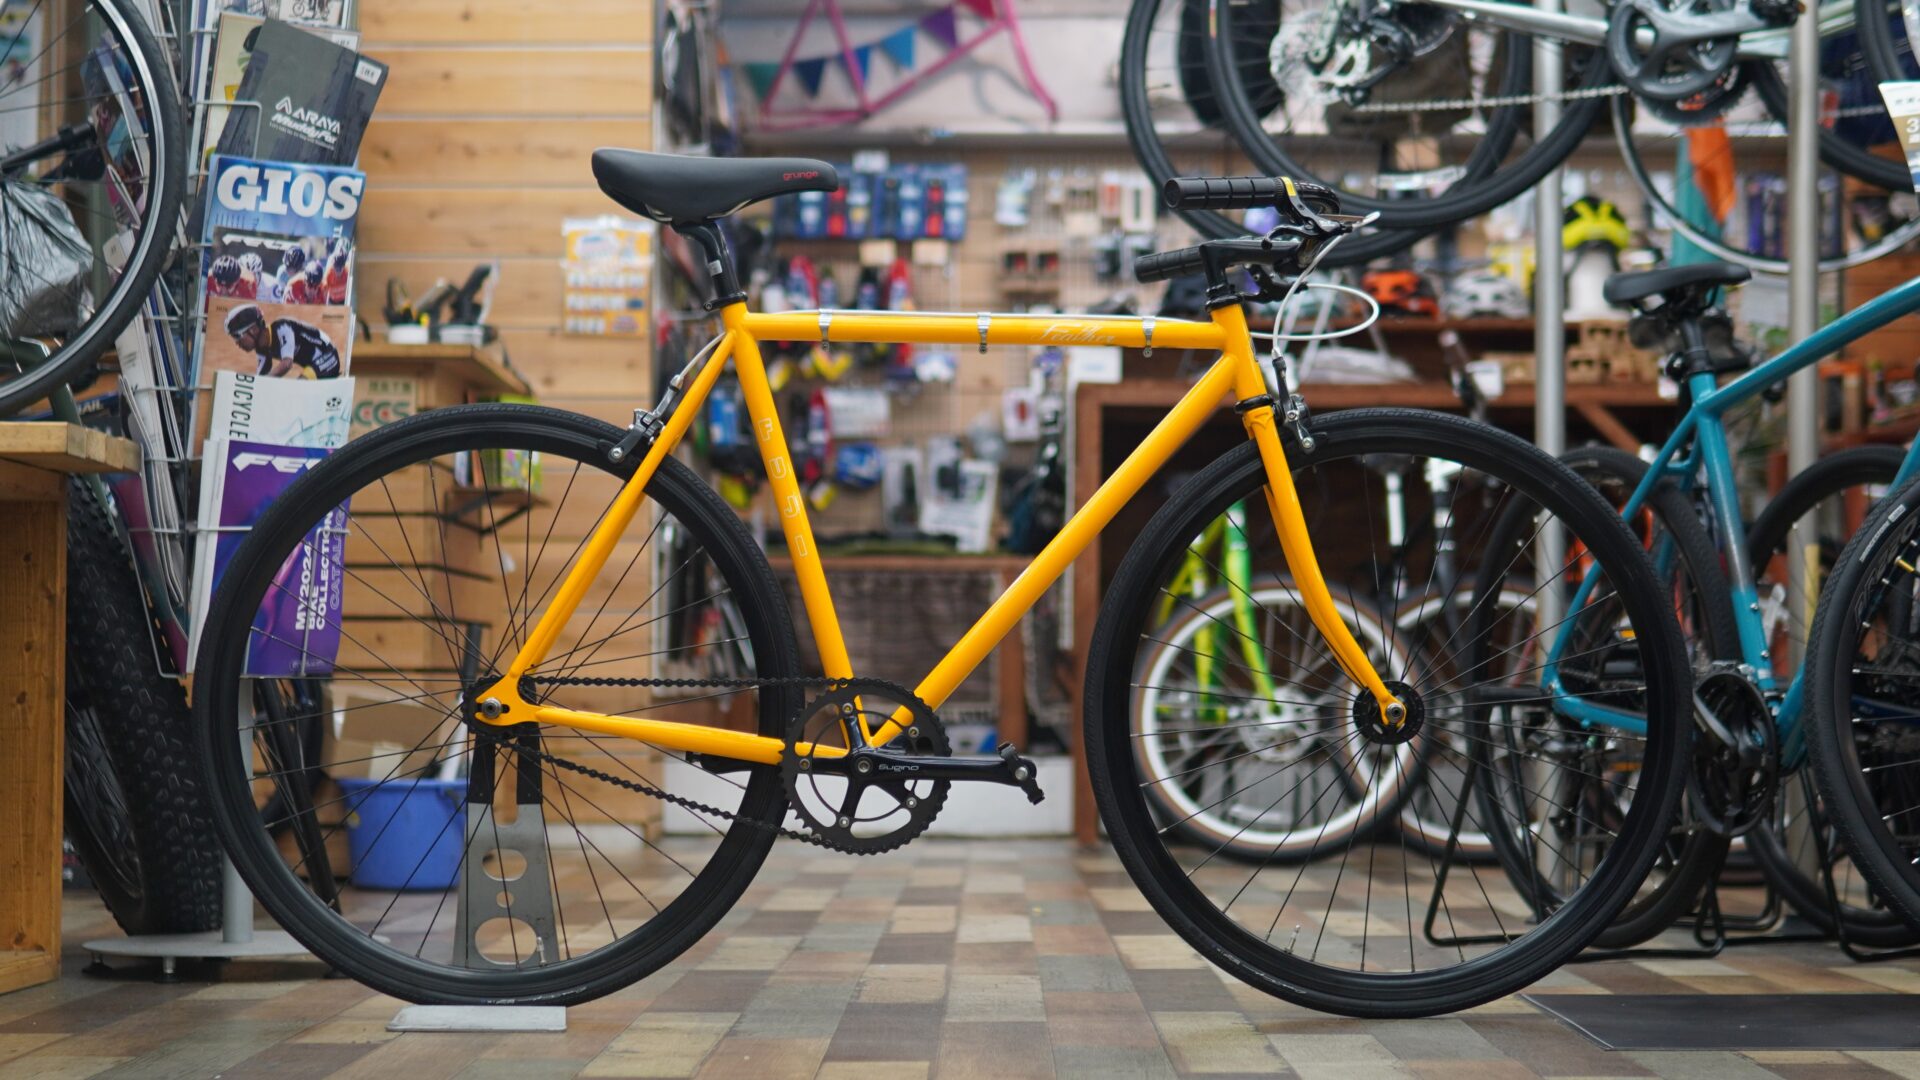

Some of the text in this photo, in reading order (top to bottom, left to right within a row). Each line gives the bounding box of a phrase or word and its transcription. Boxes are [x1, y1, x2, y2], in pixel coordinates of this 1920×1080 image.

[293, 107, 340, 134] ARAYA
[217, 164, 363, 220] GIOS
[783, 171, 818, 181] grunge
[229, 374, 255, 440] BICYCLE
[759, 417, 809, 558] FUJI
[315, 511, 334, 631] COLLECTION
[879, 763, 920, 773] Sugino
